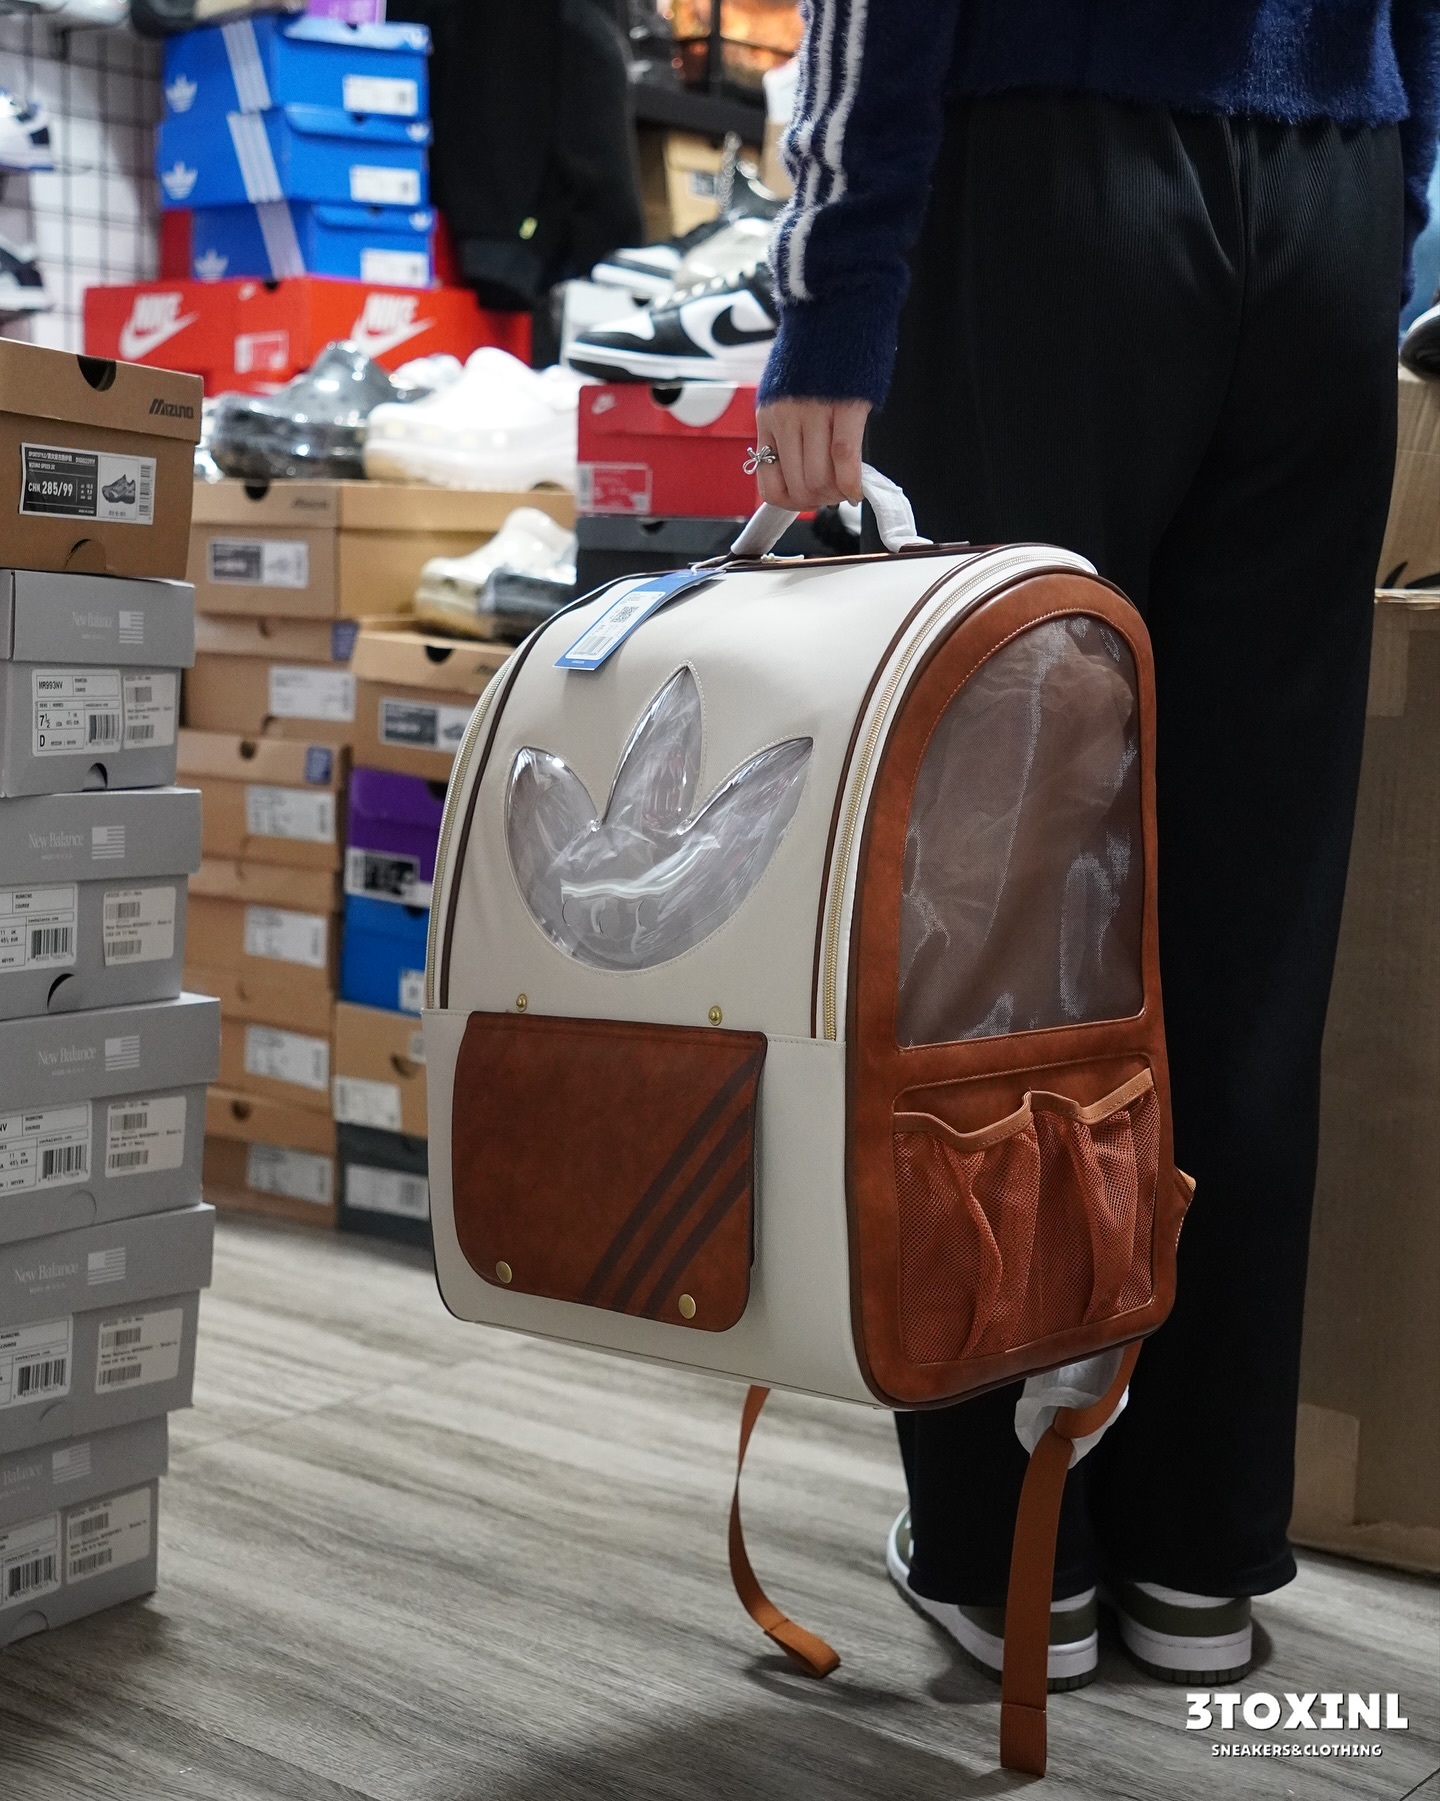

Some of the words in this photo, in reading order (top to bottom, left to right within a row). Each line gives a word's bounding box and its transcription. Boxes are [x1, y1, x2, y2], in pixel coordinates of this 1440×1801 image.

[149, 398, 194, 419] MIZUNO
[42, 480, 73, 497] 285/99
[38, 681, 63, 690] MR993NV
[40, 734, 46, 747] D
[28, 832, 48, 849] New
[50, 830, 84, 848] Balance
[38, 1051, 58, 1066] New
[60, 1045, 97, 1063] Balance
[38, 1261, 80, 1281] Balance
